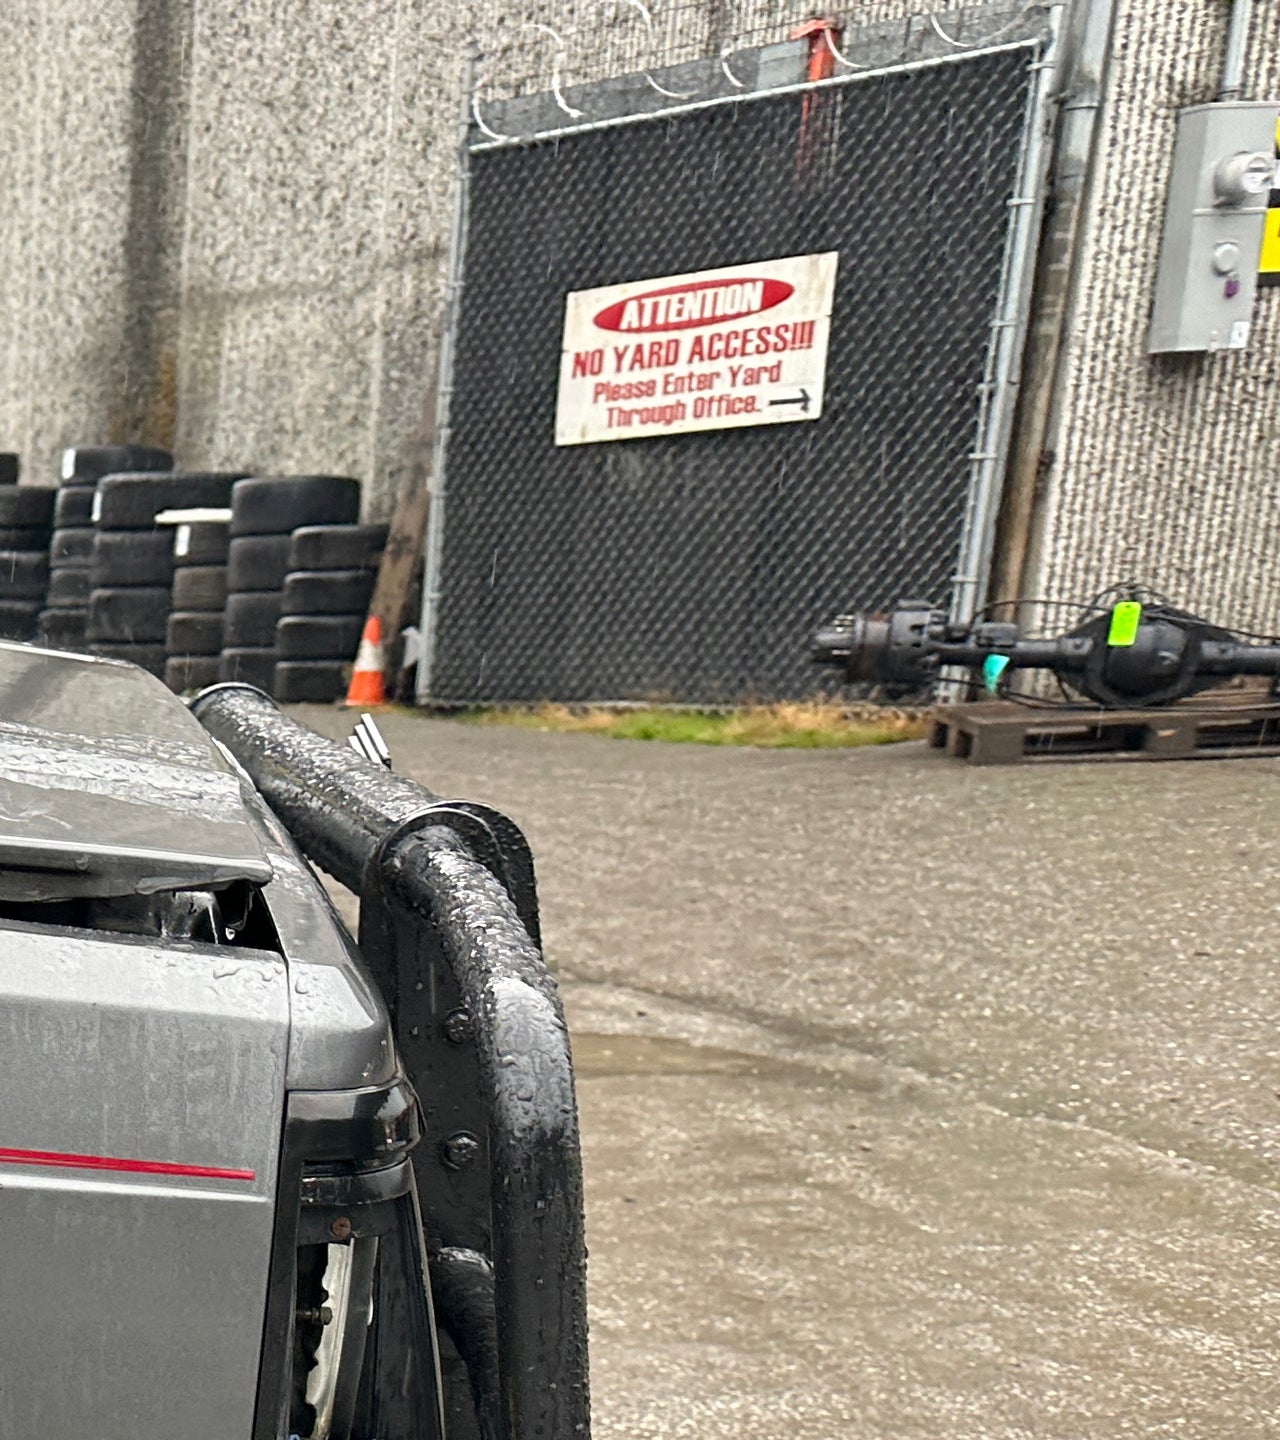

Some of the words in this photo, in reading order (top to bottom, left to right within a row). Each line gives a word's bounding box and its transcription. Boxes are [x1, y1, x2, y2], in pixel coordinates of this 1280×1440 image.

[620, 281, 764, 330] ATTENTION
[572, 349, 604, 378] NO
[613, 338, 681, 374] YARD
[687, 321, 815, 364] ACCESS!!!
[592, 378, 656, 404] Please
[662, 370, 722, 396] Enter
[729, 360, 782, 388] Yard
[606, 401, 686, 428] Through
